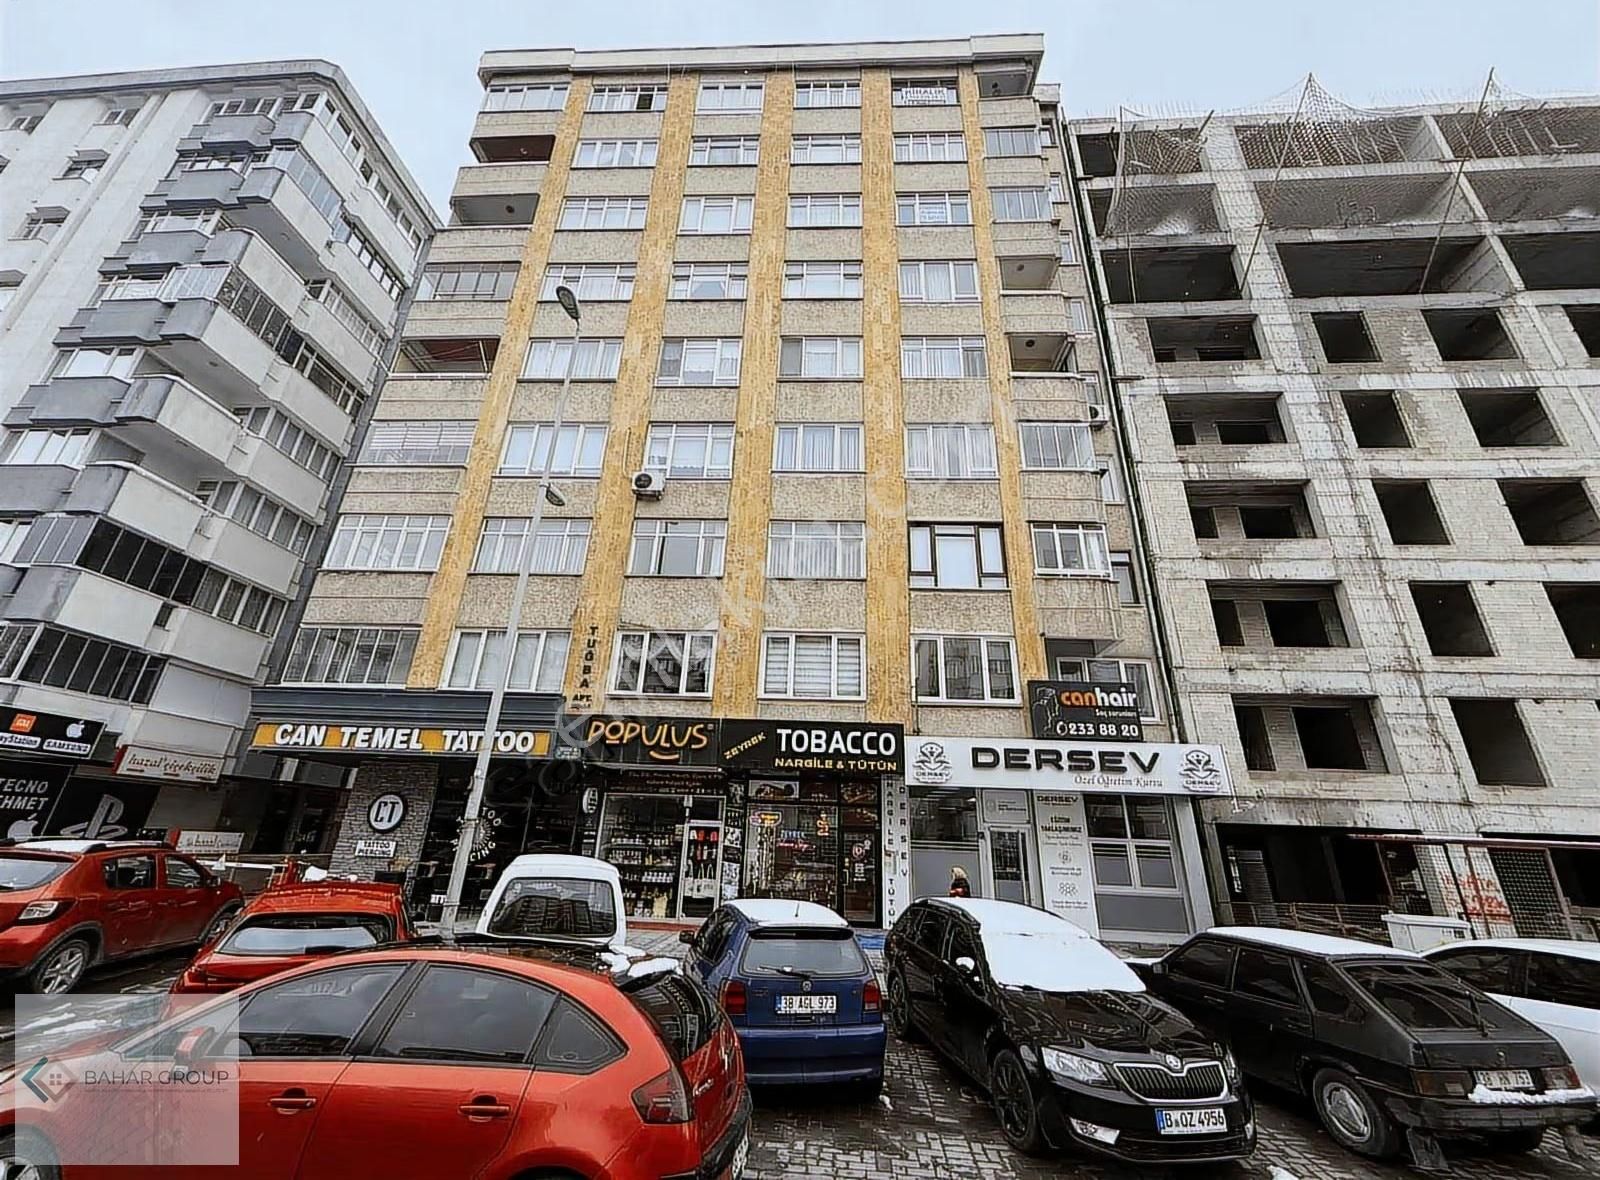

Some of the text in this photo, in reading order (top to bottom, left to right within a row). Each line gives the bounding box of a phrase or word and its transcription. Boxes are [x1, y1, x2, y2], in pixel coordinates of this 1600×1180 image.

[1061, 687, 1136, 707] canhair
[275, 723, 327, 746] CAN
[340, 726, 424, 750] TEMEL
[442, 729, 534, 753] TATOO
[587, 721, 708, 749] POPULUS
[1068, 723, 1139, 737] 233 88 20
[45, 740, 89, 753] SAMSUNG
[776, 728, 897, 756] TOBACCO
[774, 756, 897, 771] NARGİLE & TÜTÜN
[971, 747, 1161, 774] DERSEV
[374, 800, 400, 823] CT
[817, 995, 835, 1009] 973
[1164, 1112, 1173, 1128] B
